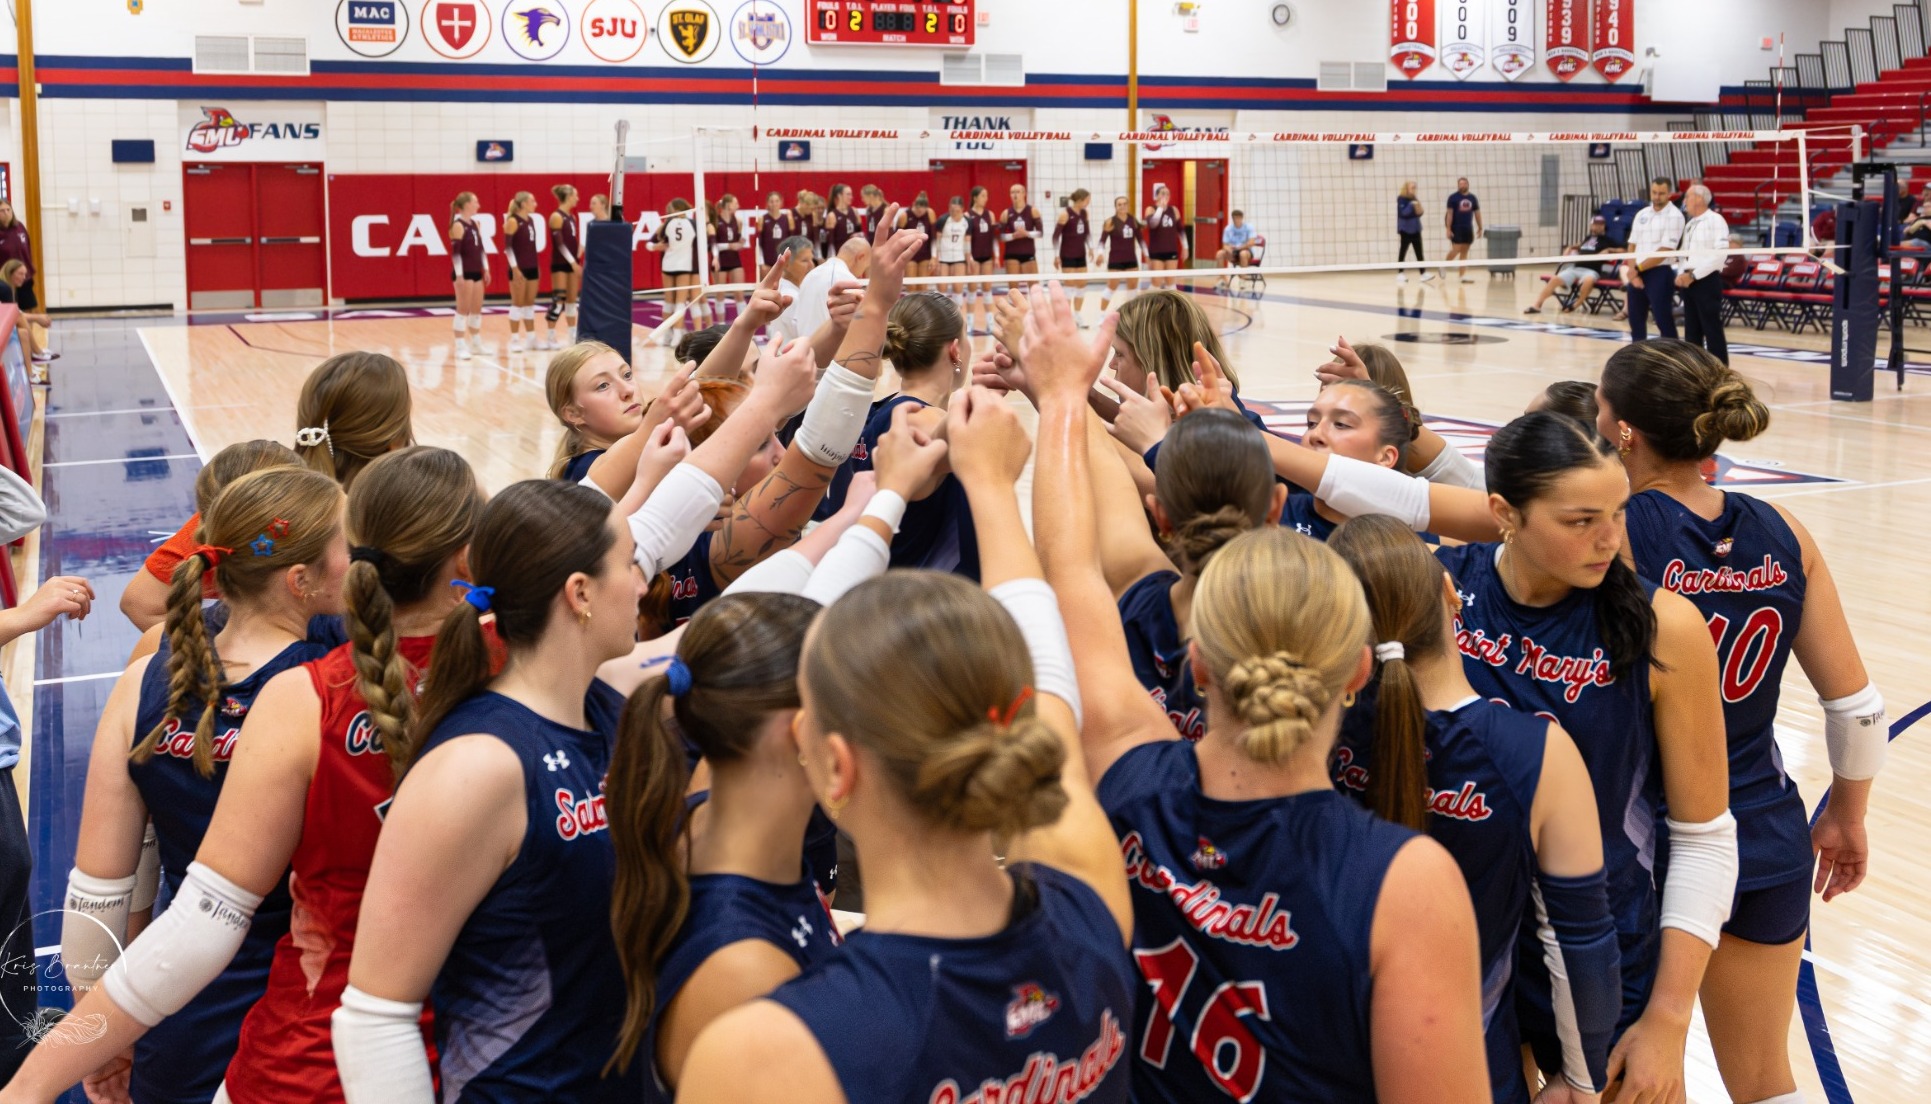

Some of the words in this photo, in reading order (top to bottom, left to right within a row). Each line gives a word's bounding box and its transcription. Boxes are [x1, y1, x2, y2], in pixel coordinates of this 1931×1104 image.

[354, 6, 390, 19] MAC
[591, 16, 637, 39] SJU
[850, 10, 862, 31] 2
[925, 13, 938, 33] 2
[942, 116, 1012, 130] THANK
[249, 123, 320, 139] FANS
[766, 128, 826, 138] CARDINAL
[829, 130, 898, 139] VOLLEYBALL
[950, 130, 1005, 140] CARDINAL
[1008, 131, 1072, 141] VOLLEYBALL
[1119, 132, 1170, 141] CARDINAL
[1172, 132, 1230, 141] VOLLEYBALL
[1273, 133, 1320, 141] CARDINAL
[1322, 133, 1376, 142] VOLLEYBALL
[1416, 133, 1459, 141] CARDINAL
[1461, 133, 1512, 141] VOLLEYBALL
[675, 227, 682, 241] 5
[1515, 636, 1616, 703] Mary's
[1133, 935, 1272, 1104] 16
